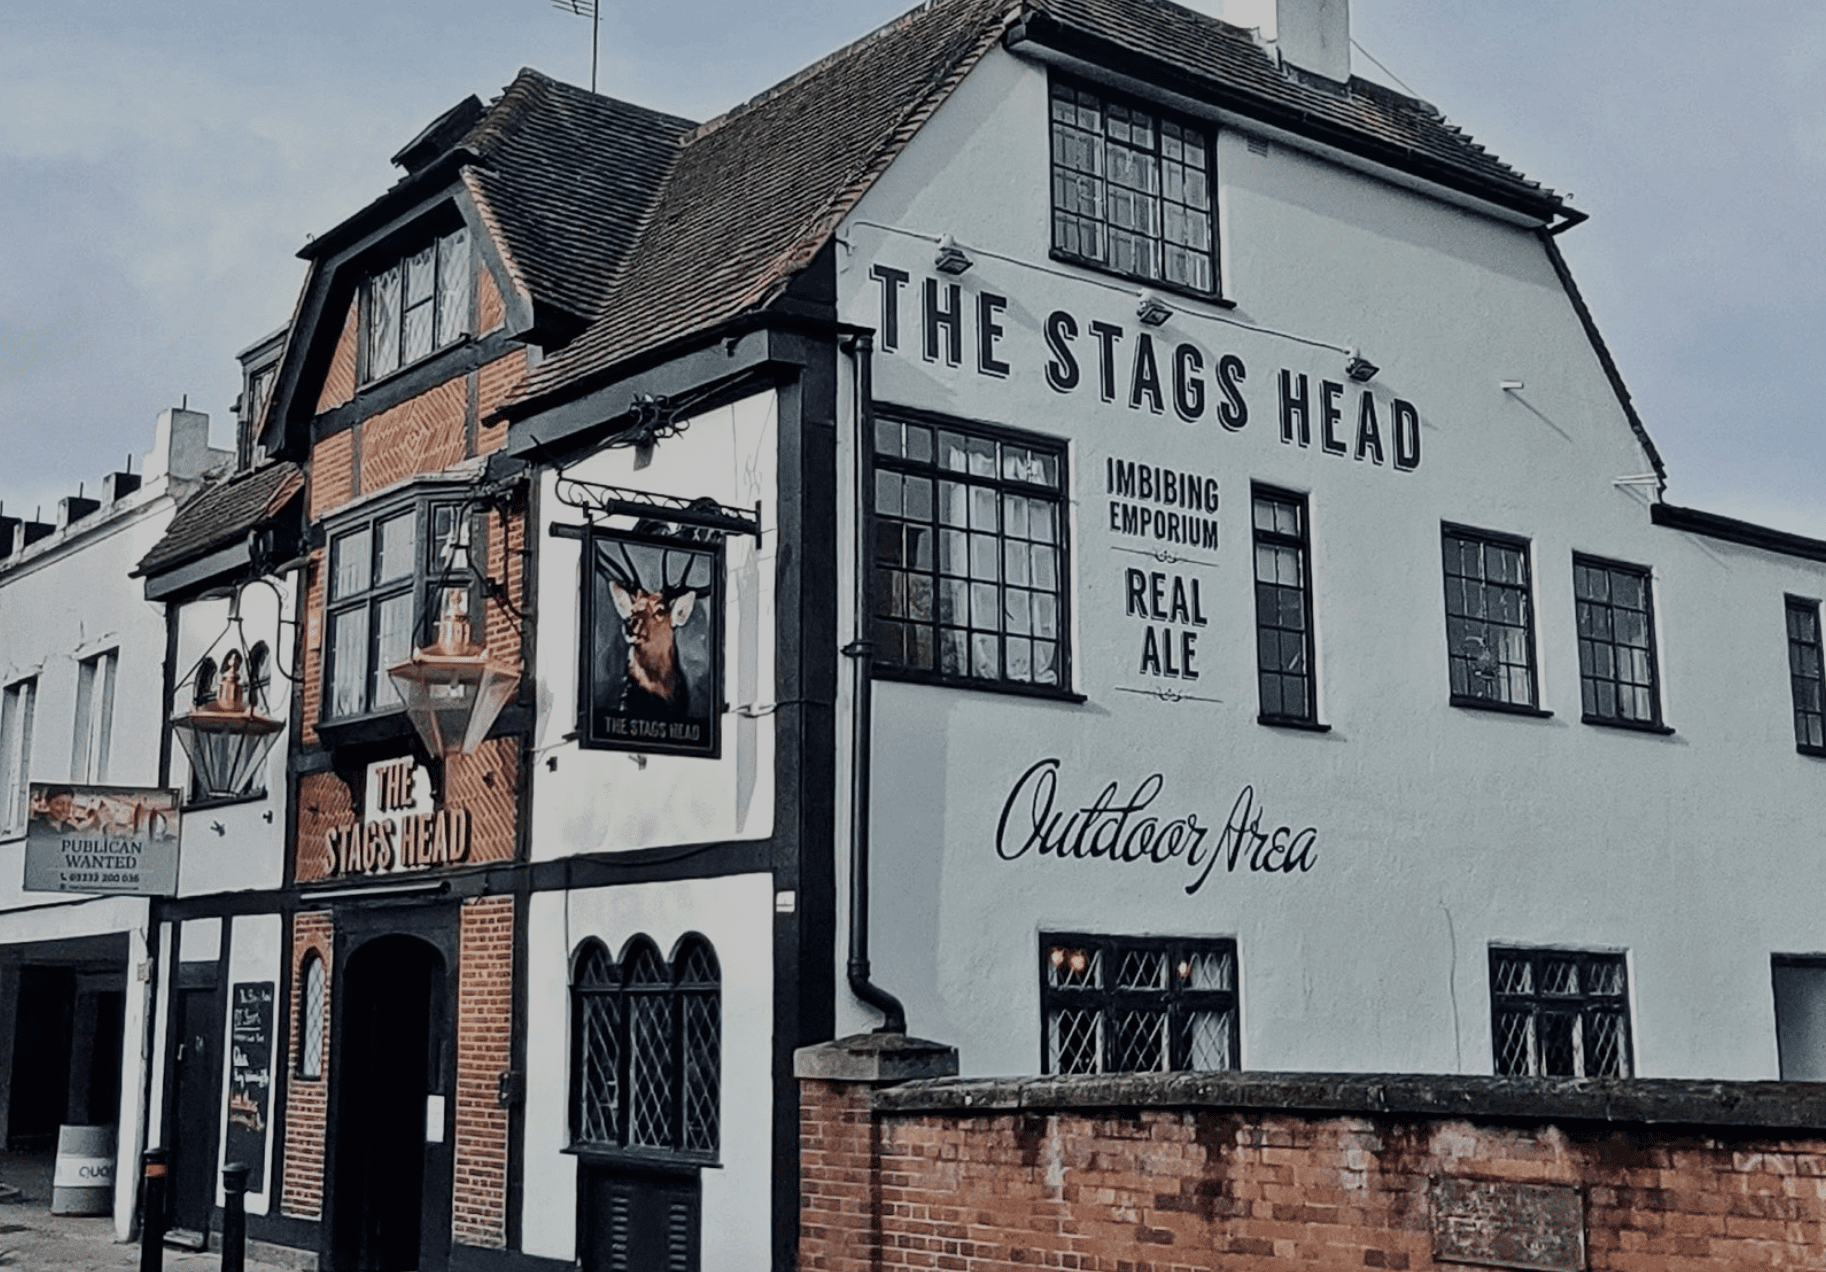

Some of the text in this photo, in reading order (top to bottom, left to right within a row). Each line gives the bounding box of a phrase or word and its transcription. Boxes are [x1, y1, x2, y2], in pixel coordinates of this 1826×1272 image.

[870, 264, 1421, 472] THE STAGS HEAD
[1107, 457, 1219, 514] IMBIBING
[1109, 501, 1219, 551] EMPORIUM
[1125, 567, 1208, 626] REAL
[1139, 627, 1200, 679] ALE
[604, 716, 700, 741] THE STAGS HEAD
[375, 761, 416, 812] THE
[61, 839, 142, 854] PUBLICAN
[324, 808, 470, 875] STAGS HEAD
[995, 758, 1318, 895] Outdoor Area
[65, 855, 137, 869] WANTED
